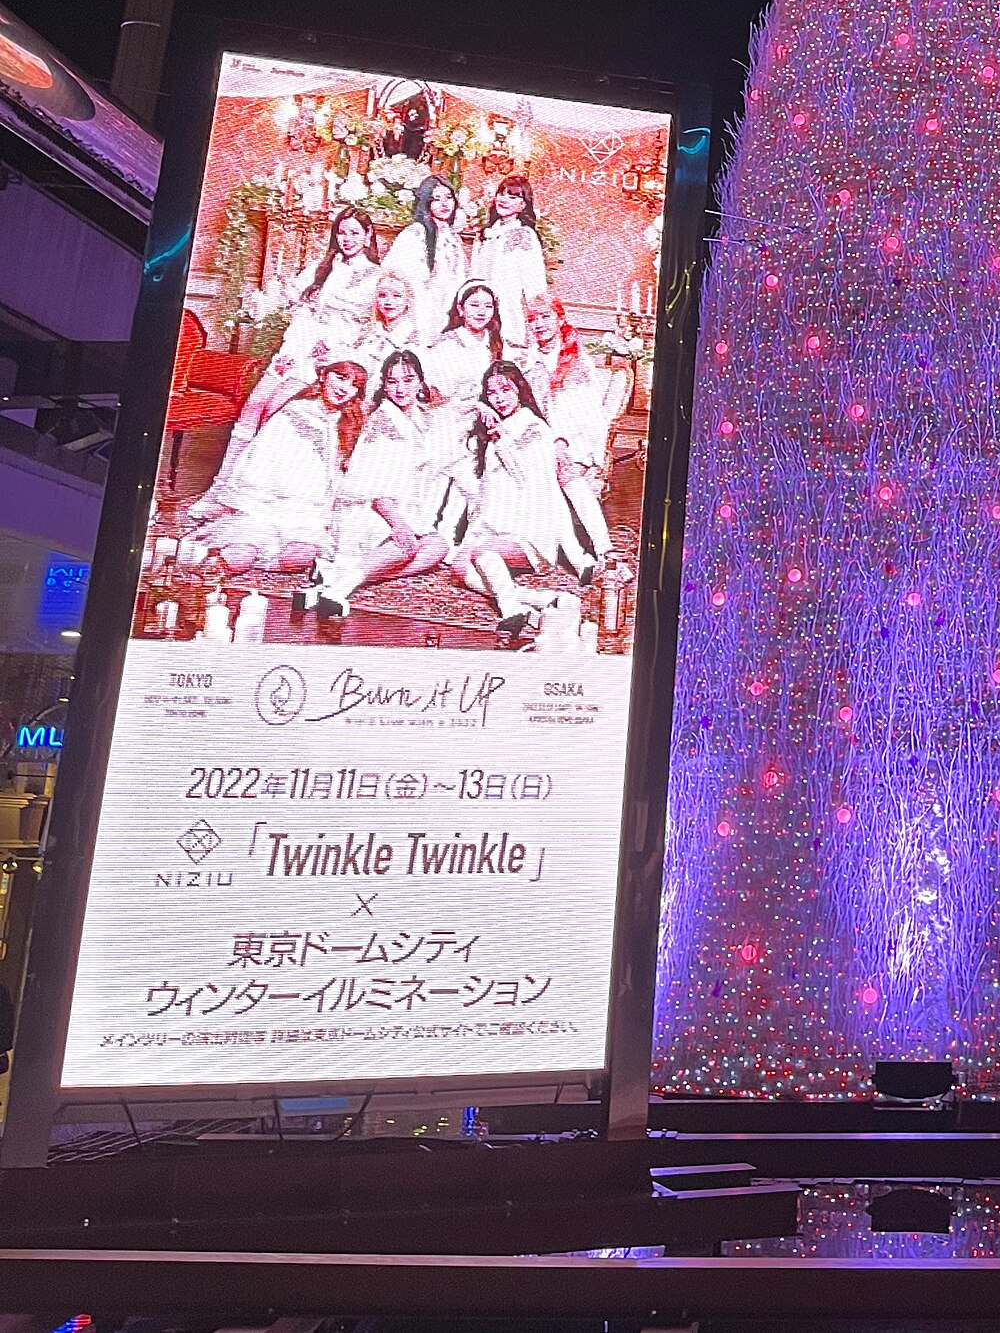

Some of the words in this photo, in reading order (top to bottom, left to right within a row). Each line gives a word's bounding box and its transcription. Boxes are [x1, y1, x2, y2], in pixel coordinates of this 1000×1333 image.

[304, 667, 422, 722] Burn
[420, 678, 453, 713] it
[18, 726, 64, 748] ML
[226, 930, 482, 968] 東京ドームシティ
[146, 974, 553, 1017] ウィンターイルミネーション
